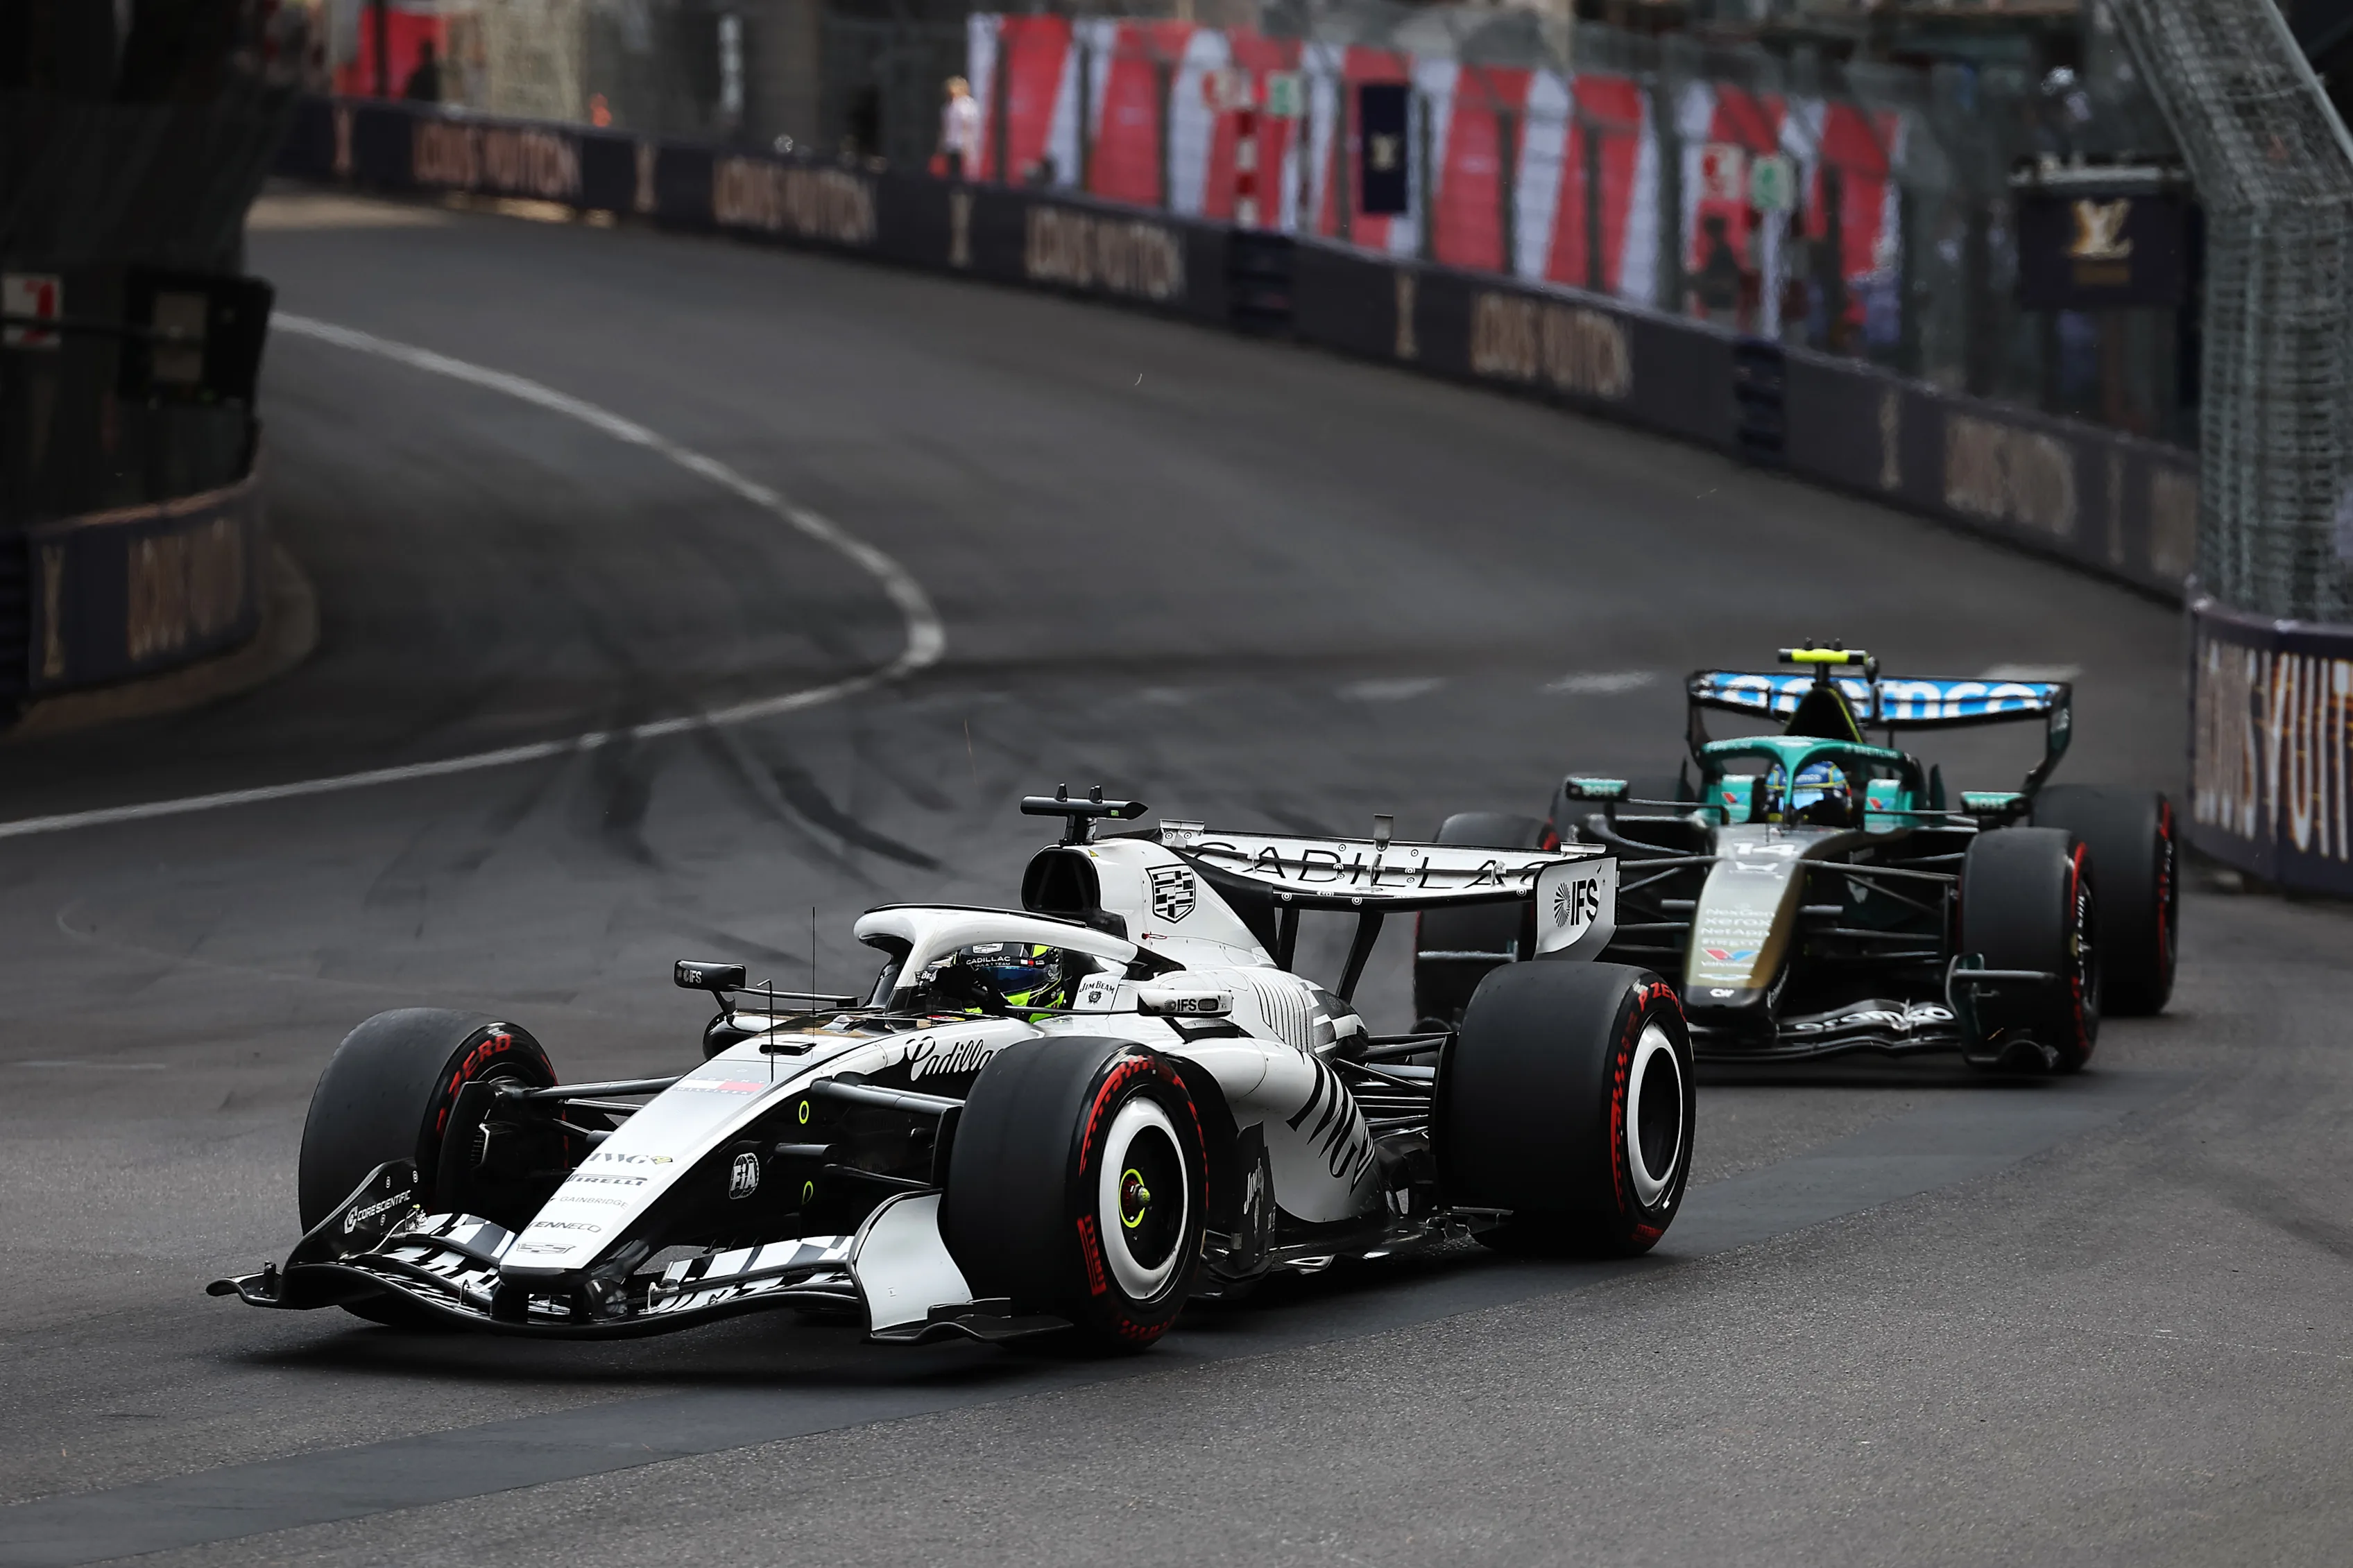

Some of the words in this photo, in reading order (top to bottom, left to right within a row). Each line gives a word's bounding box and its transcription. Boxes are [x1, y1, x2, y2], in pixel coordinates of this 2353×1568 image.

[1734, 843, 1799, 856] 14
[1570, 878, 1600, 927] IFS
[966, 956, 1011, 965] CADILLAC
[689, 970, 703, 984] IFS
[1176, 999, 1197, 1012] IFS
[565, 1173, 648, 1187] PIRELLI
[559, 1196, 629, 1210] GAINBRIDGE
[1077, 1214, 1107, 1296] PIRELLI
